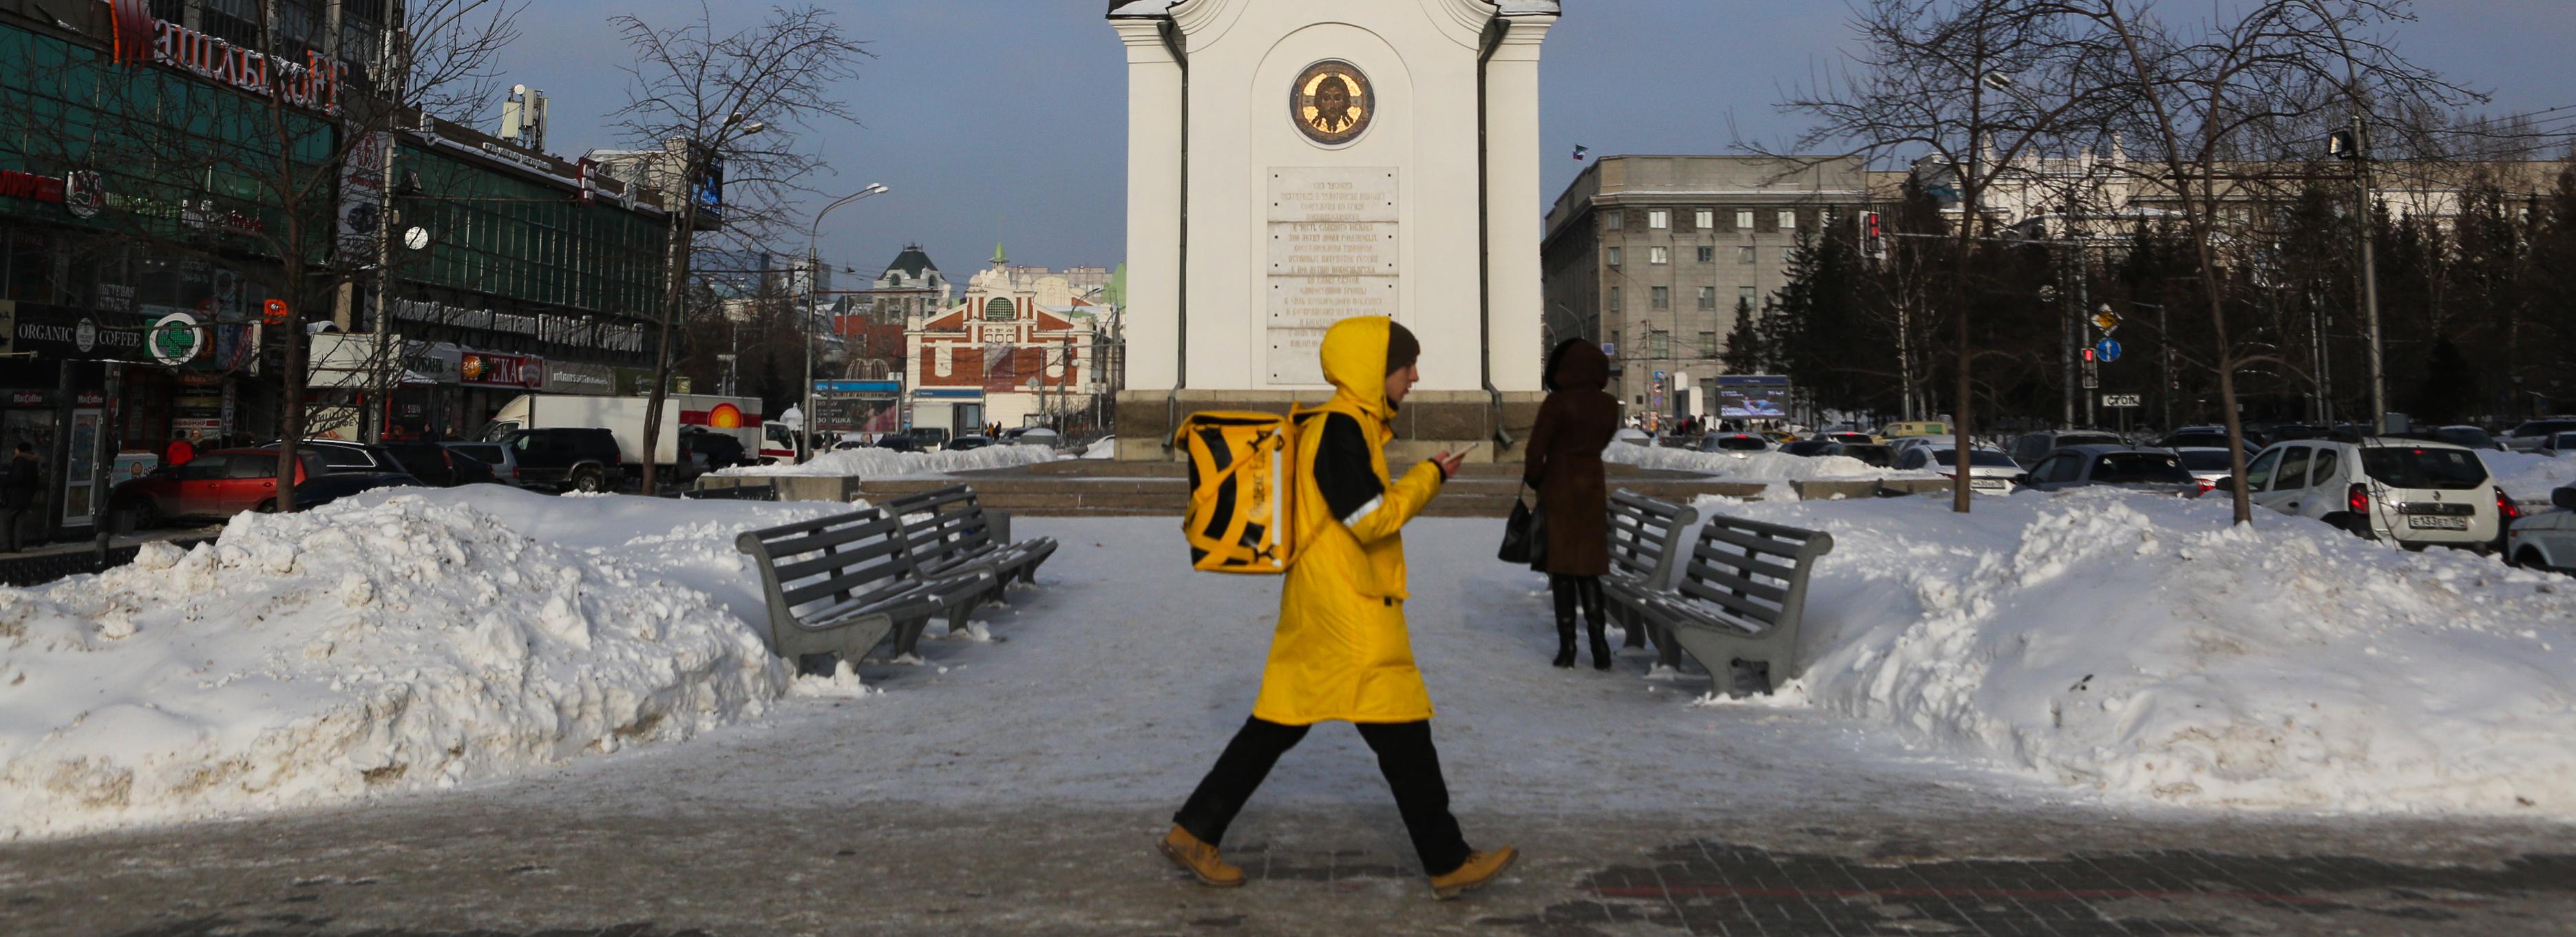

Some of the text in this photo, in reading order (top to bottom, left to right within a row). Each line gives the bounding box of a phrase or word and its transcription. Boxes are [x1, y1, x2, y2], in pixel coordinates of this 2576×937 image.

[19, 324, 73, 342] ORGANIC
[98, 329, 141, 347] COFFEE
[14, 393, 43, 403] MacCoffee
[78, 394, 103, 403] MacCoffee
[2107, 396, 2137, 406] СТОП
[329, 418, 355, 430] КОФЕ
